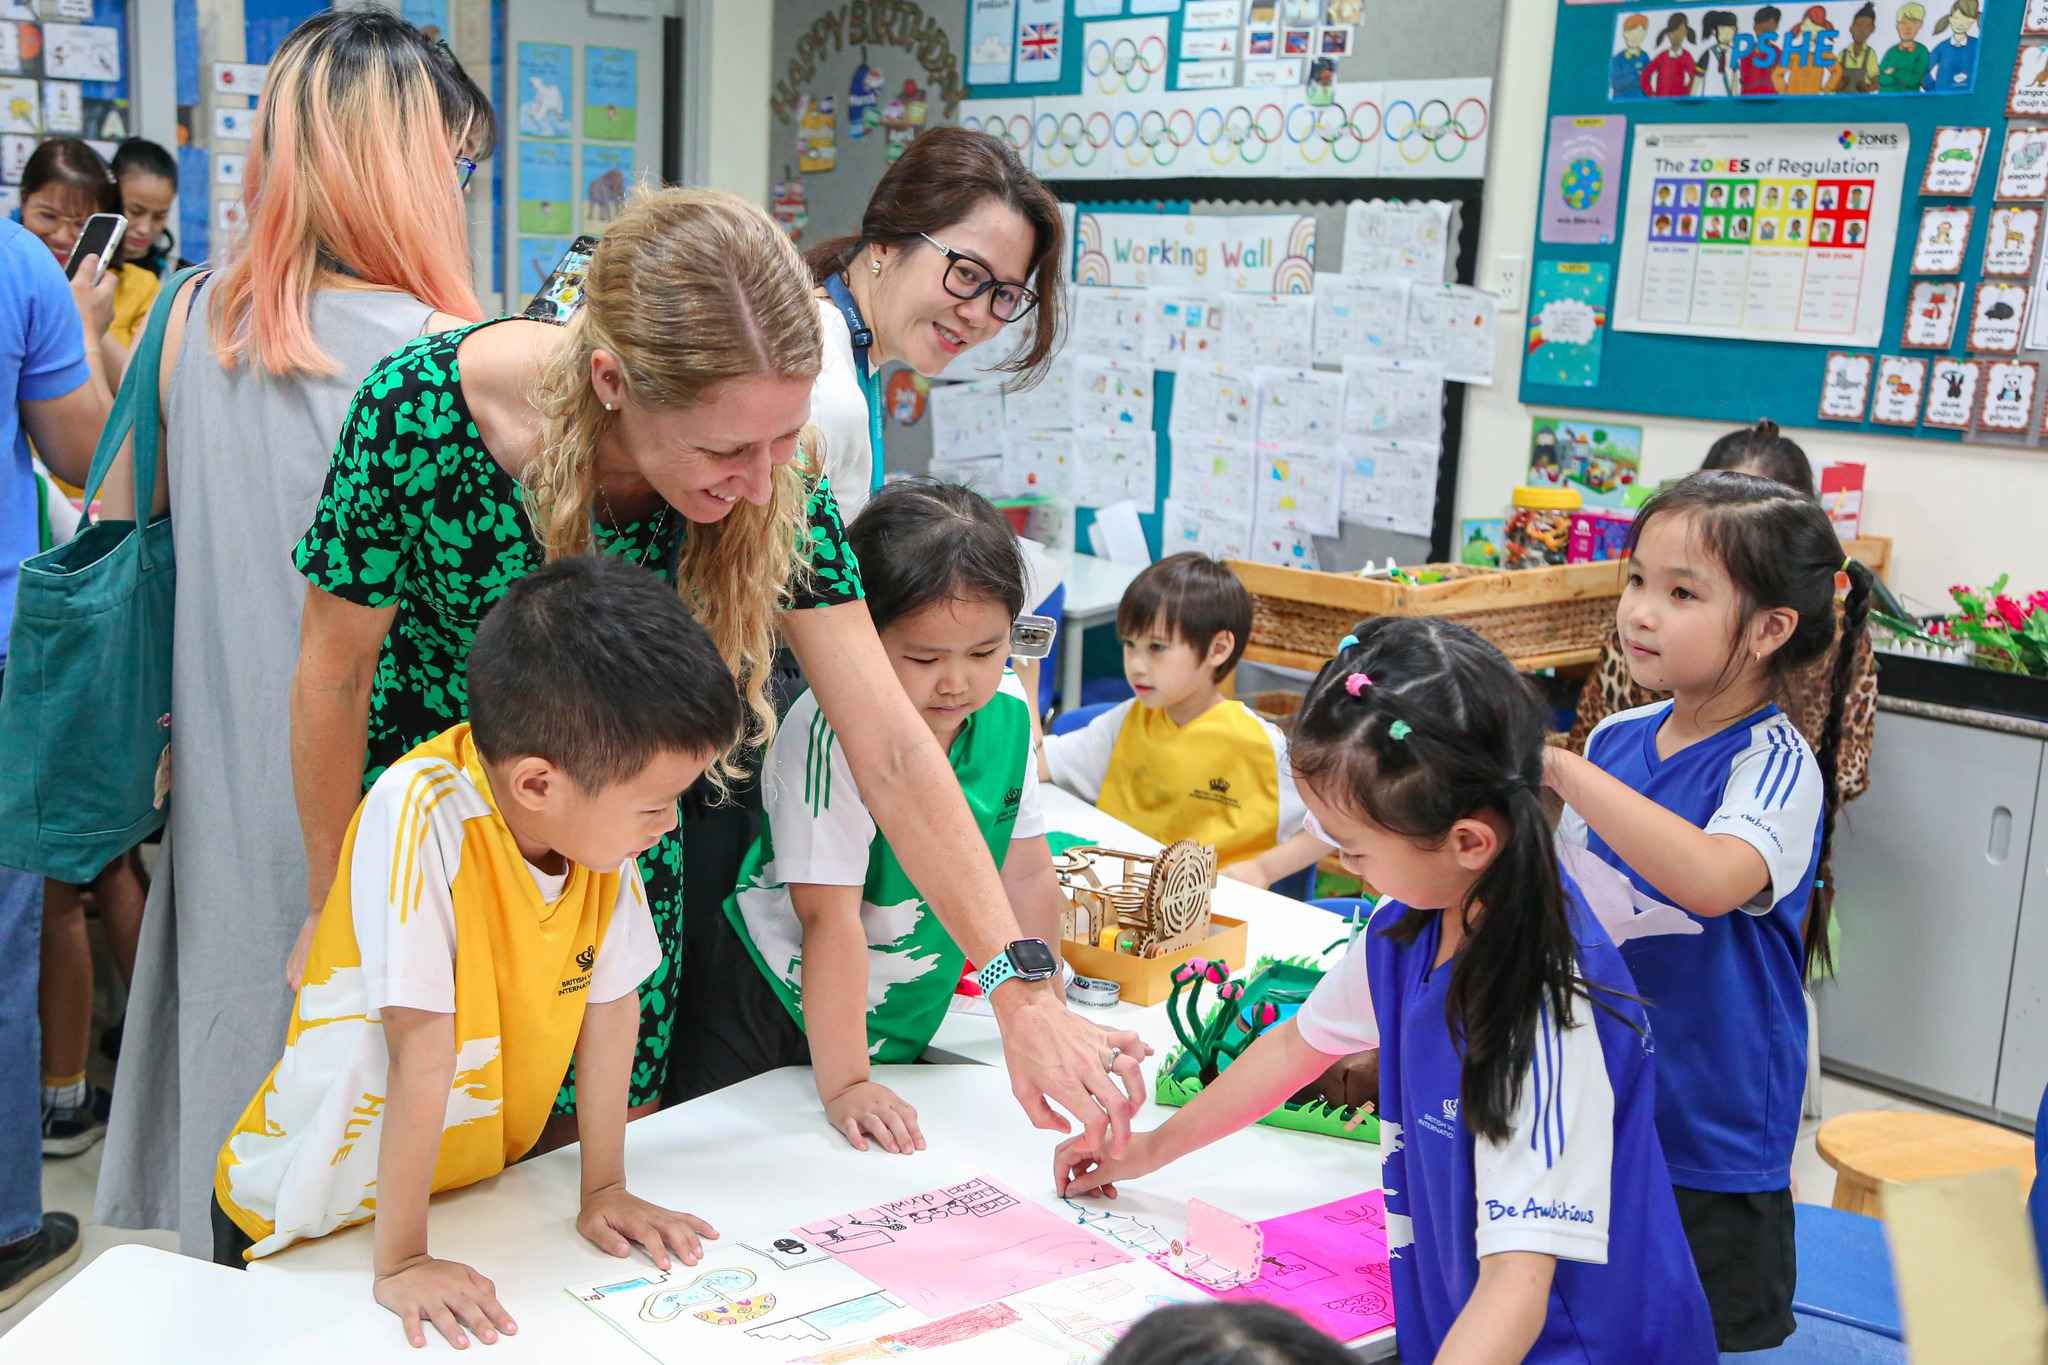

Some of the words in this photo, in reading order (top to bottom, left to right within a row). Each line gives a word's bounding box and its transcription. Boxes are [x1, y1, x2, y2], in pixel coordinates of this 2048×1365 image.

[1729, 29, 1840, 70] PSHE
[1654, 158, 1685, 174] The
[1689, 159, 1750, 173] ZONES
[1755, 158, 1774, 174] of
[1778, 159, 1880, 177] Regulation
[1113, 238, 1208, 276] Working
[1221, 238, 1273, 269] Wall
[330, 1092, 386, 1168] HUE
[1485, 1199, 1518, 1222] Be
[1522, 1197, 1595, 1225] Ambitious
